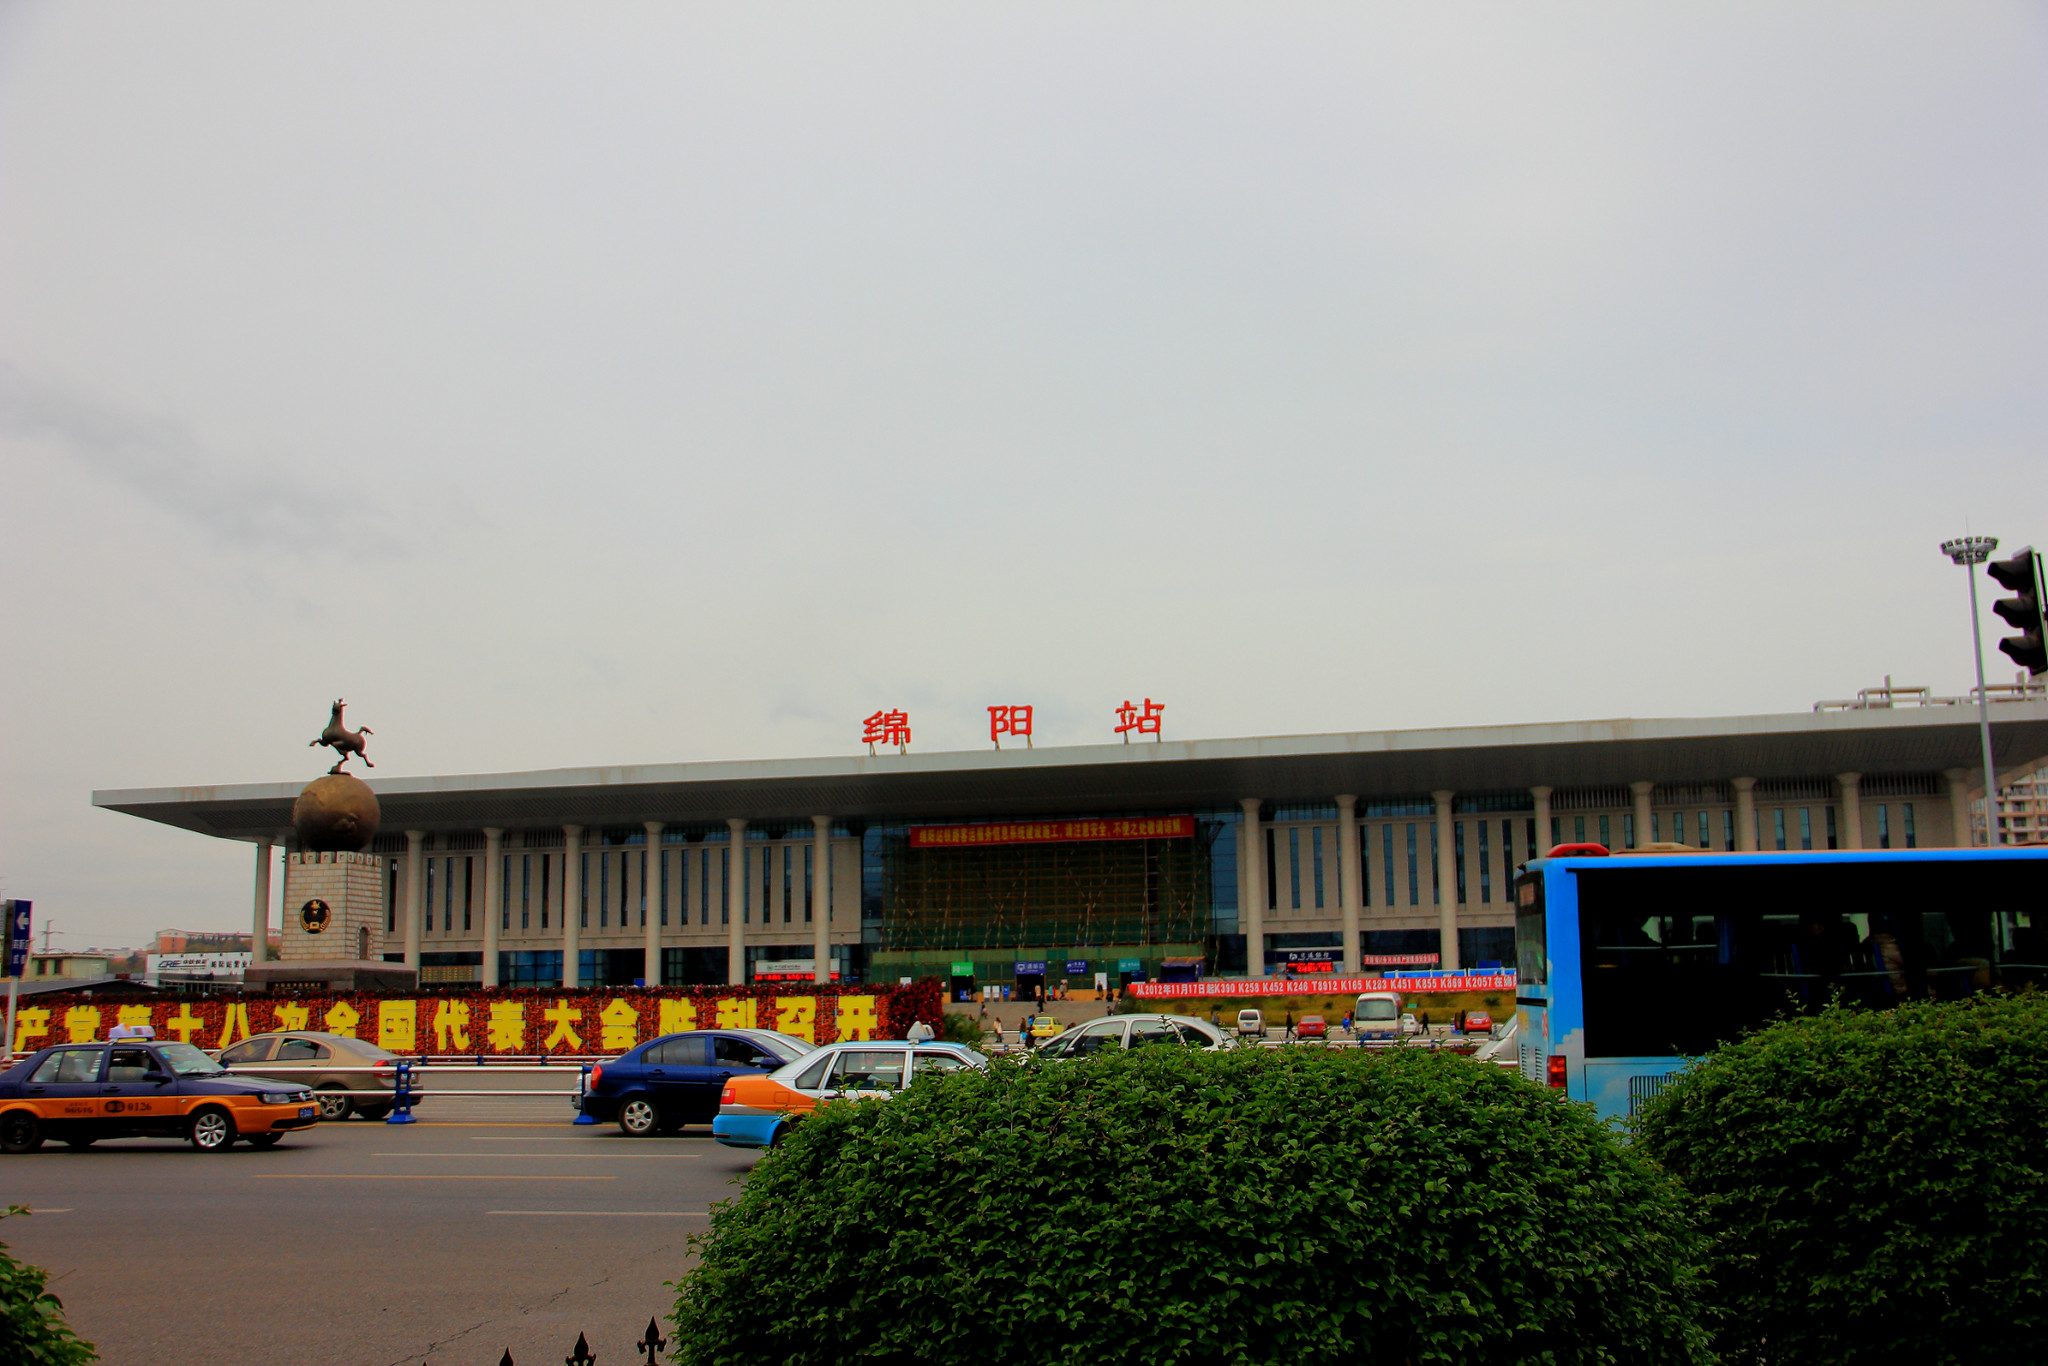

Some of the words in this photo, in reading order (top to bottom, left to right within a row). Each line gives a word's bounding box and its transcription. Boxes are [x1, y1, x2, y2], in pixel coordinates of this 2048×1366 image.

[862, 698, 1165, 745] 绵阳站
[211, 960, 253, 968] 绵阳站营业
[1238, 982, 1259, 993] K258
[1262, 982, 1283, 992] K452
[1287, 981, 1308, 992] K246
[1311, 981, 1337, 992] T8912
[1390, 979, 1411, 990] K451
